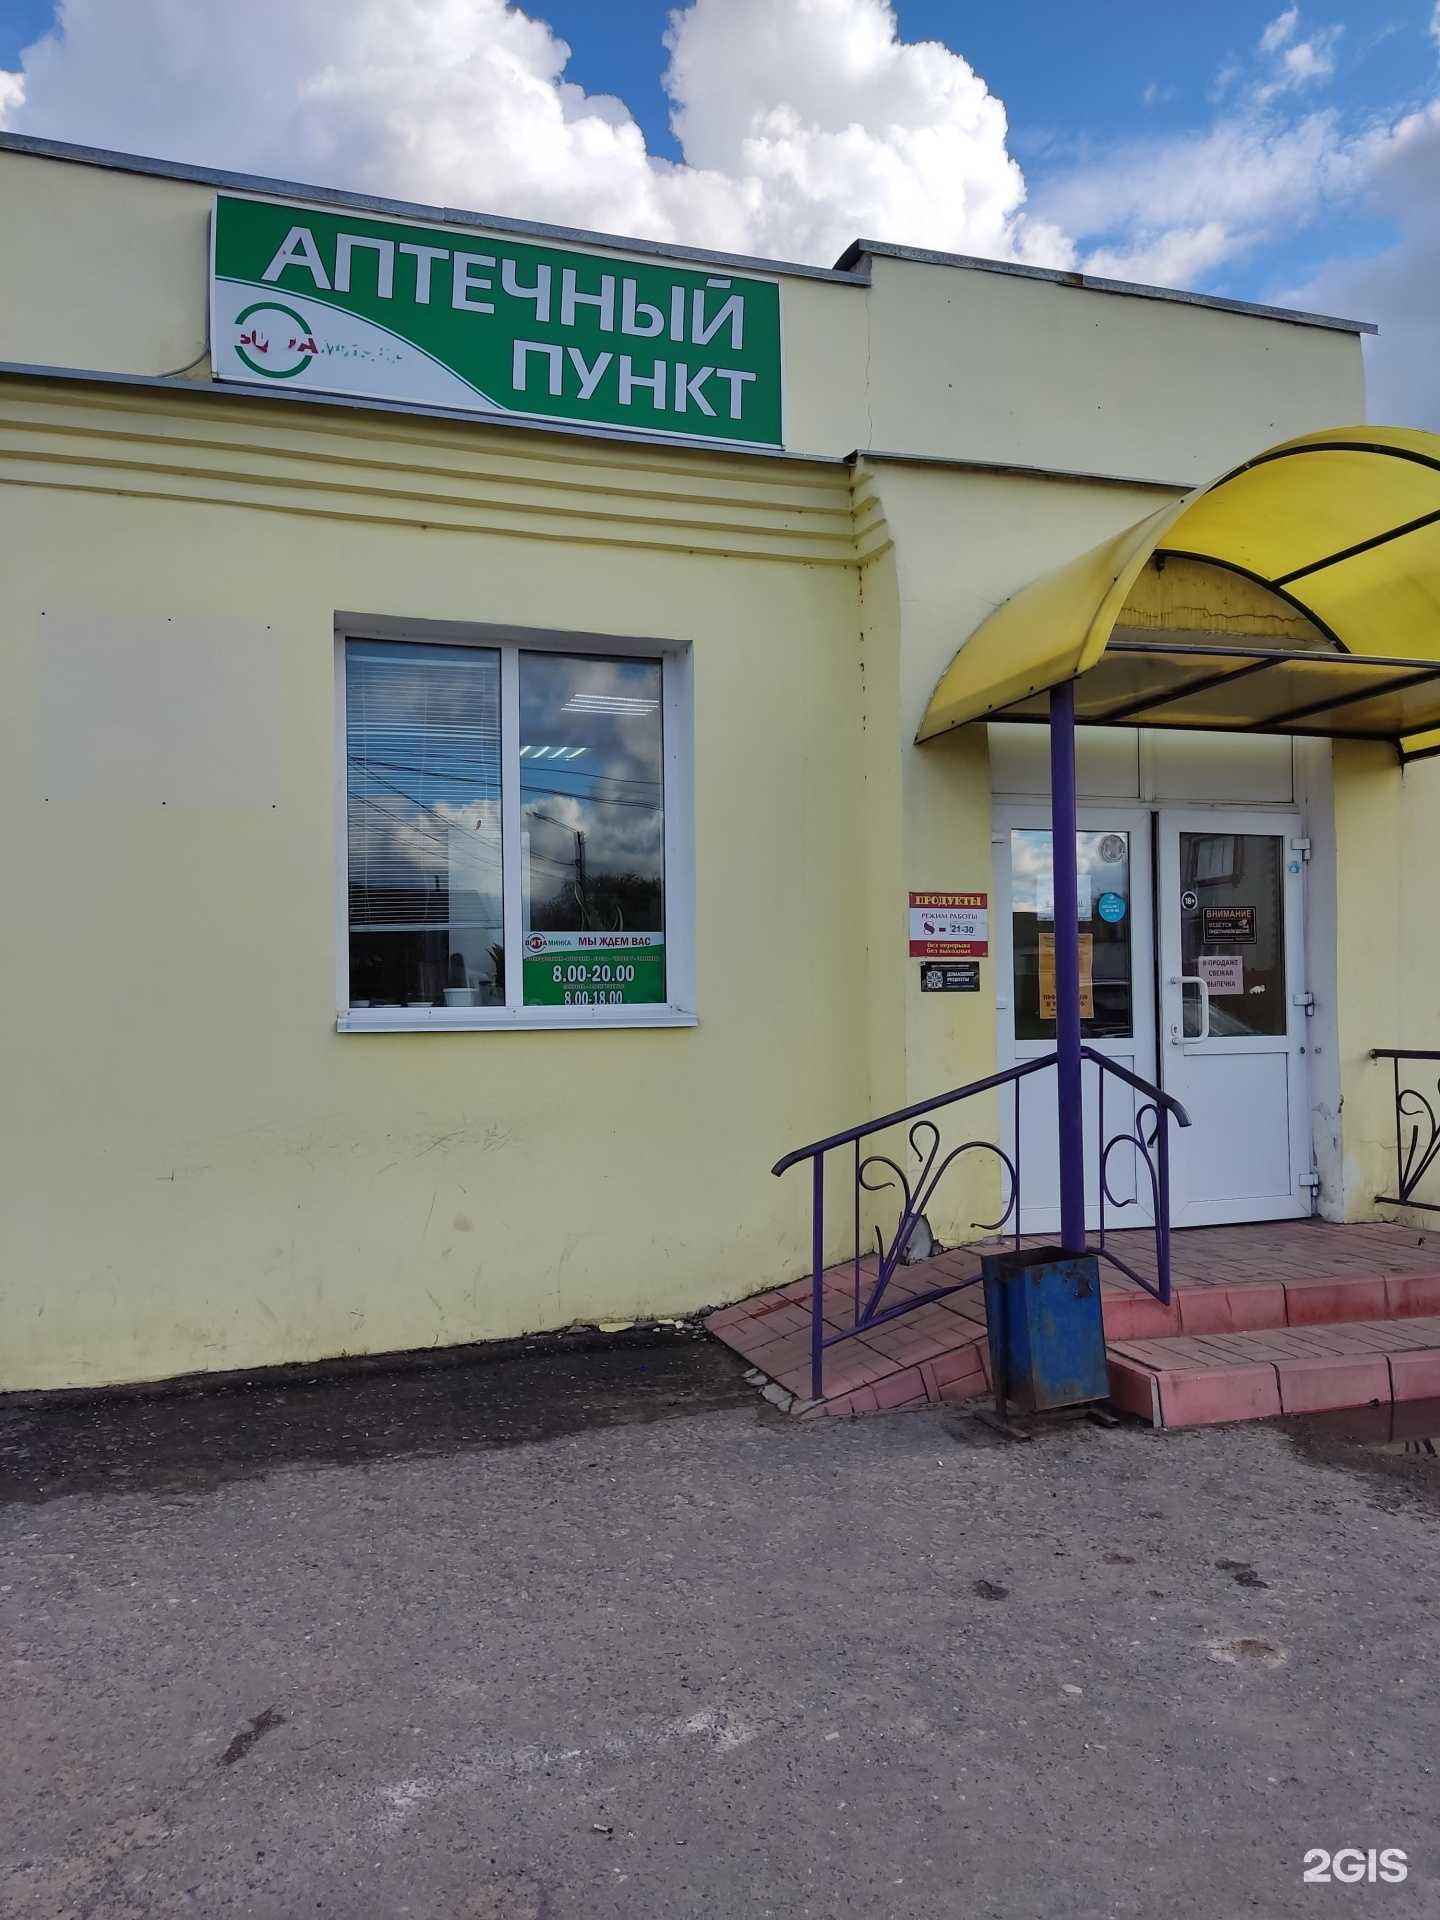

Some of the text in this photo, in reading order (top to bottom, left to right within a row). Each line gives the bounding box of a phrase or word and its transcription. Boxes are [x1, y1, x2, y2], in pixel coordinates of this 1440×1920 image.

[261, 225, 745, 351] АПТЕЧНЫЙ
[511, 339, 758, 420] ПУНКТ
[915, 896, 981, 905] ПРОДУКТЫ
[1184, 897, 1195, 905] 18+
[1206, 909, 1252, 918] ВНИМАНИЕ
[578, 936, 597, 946] МЫ
[599, 936, 629, 947] ЖДЕМ
[631, 936, 651, 946] ВАС
[1208, 959, 1240, 967] ПРОДАЖЕ
[552, 964, 635, 983] 8.00-20.00
[564, 990, 623, 1005] 8.00-18.00
